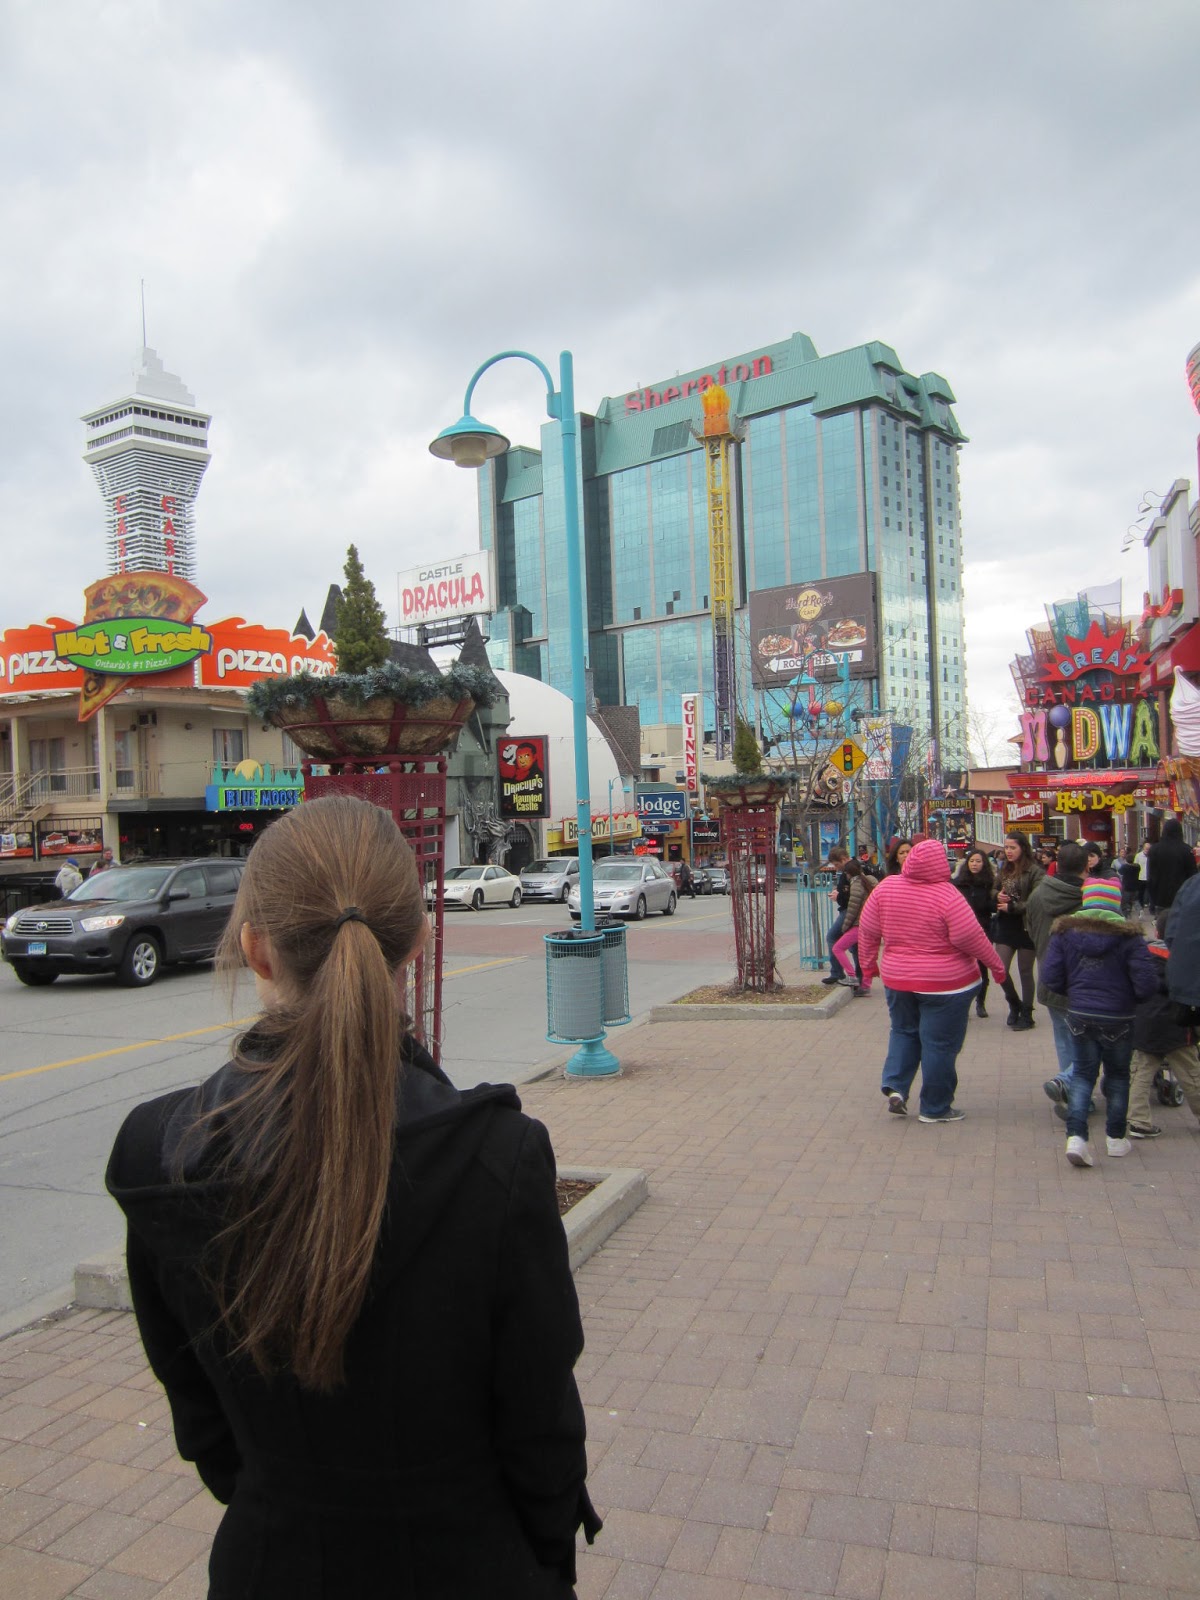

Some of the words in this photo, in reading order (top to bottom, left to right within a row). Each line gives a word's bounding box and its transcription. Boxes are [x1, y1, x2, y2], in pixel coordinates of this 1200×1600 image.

[625, 354, 773, 416] Sheraton
[419, 563, 463, 582] CASTLE
[402, 572, 484, 618] DRACULA
[54, 631, 111, 657] Hot
[114, 634, 128, 650] &
[130, 626, 211, 655] Fresh
[95, 659, 131, 670] Ontario's
[133, 660, 143, 669] #1
[145, 656, 172, 669] Pizza!
[217, 648, 288, 678] pizza
[1058, 648, 1137, 677] GREAT
[1025, 682, 1158, 705] CANADIA
[684, 700, 696, 791] GUINNES
[1021, 699, 1160, 769] MIDWA
[226, 790, 257, 807] BLUE
[260, 790, 300, 806] MOOSE
[513, 793, 542, 803] Haunted
[516, 802, 538, 811] Castle
[928, 799, 972, 810] MOVIELAND
[1055, 791, 1086, 814] Hot
[1091, 790, 1134, 814] Dogs
[591, 820, 606, 837] CITY
